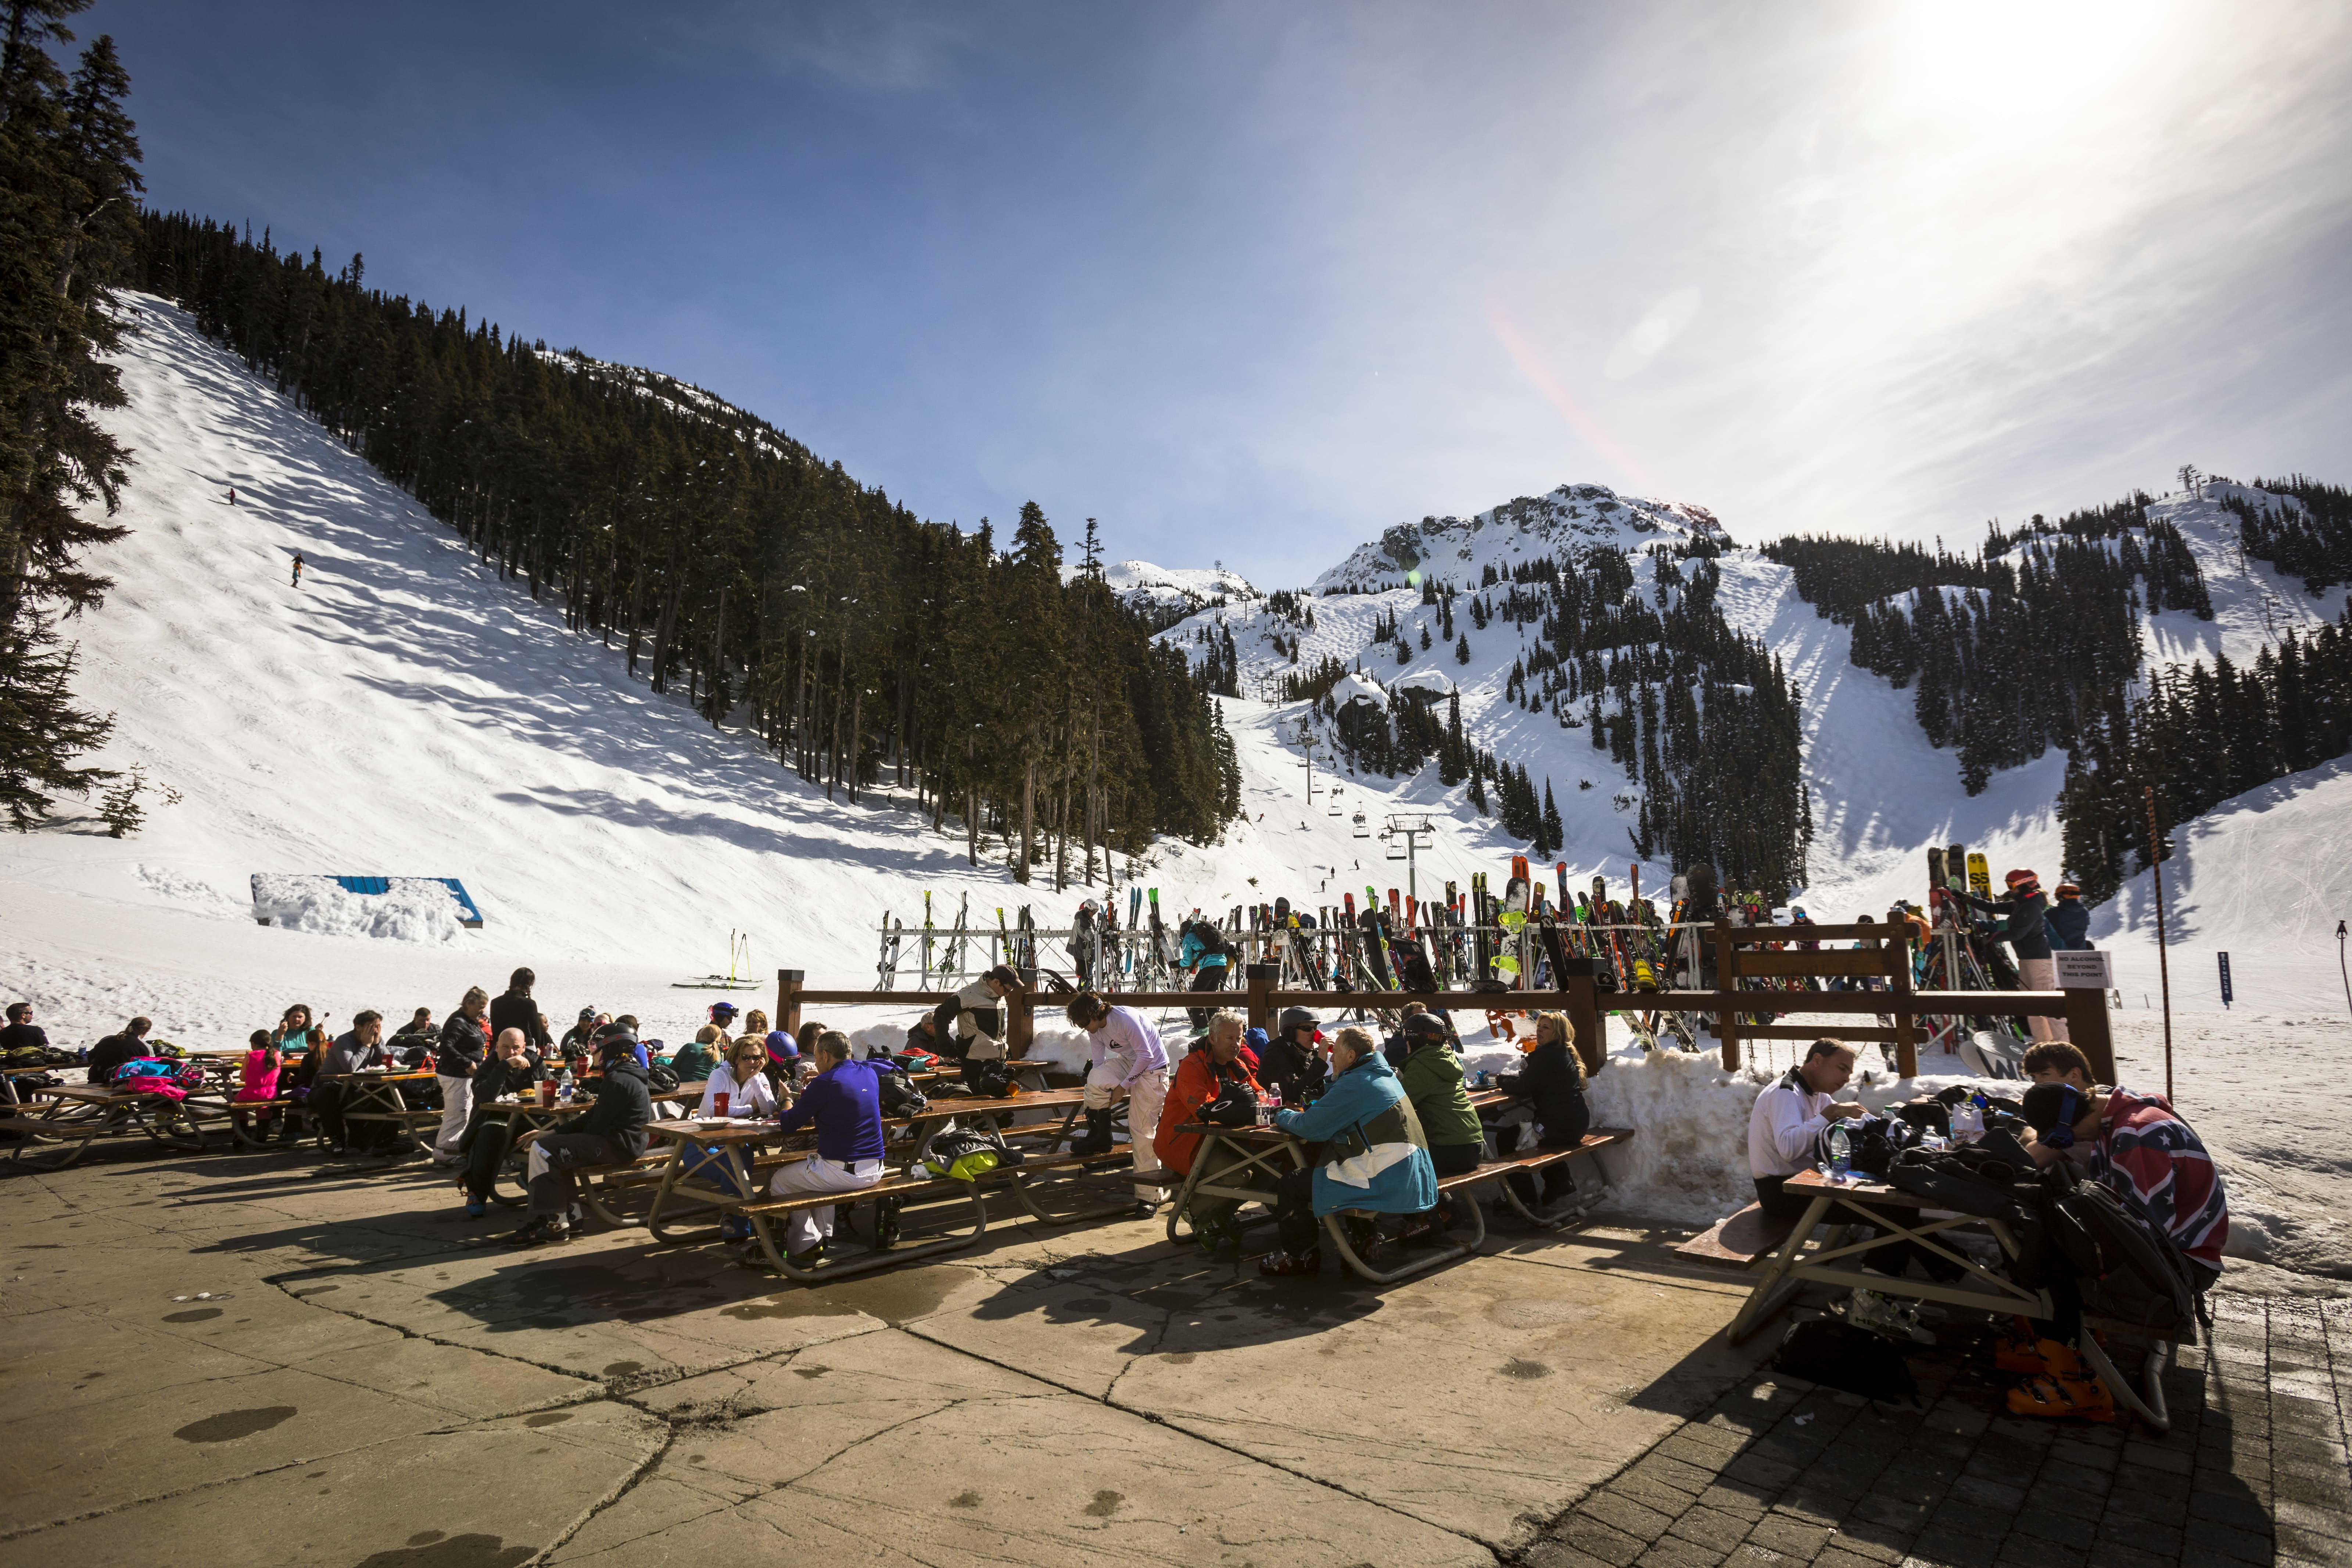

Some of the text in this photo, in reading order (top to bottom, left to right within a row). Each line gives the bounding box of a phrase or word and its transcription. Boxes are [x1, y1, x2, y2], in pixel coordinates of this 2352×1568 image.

[1407, 1225, 1429, 1237] HEAD
[1856, 1317, 1901, 1332] HEAD
[2064, 1405, 2103, 1414] TECNICA
